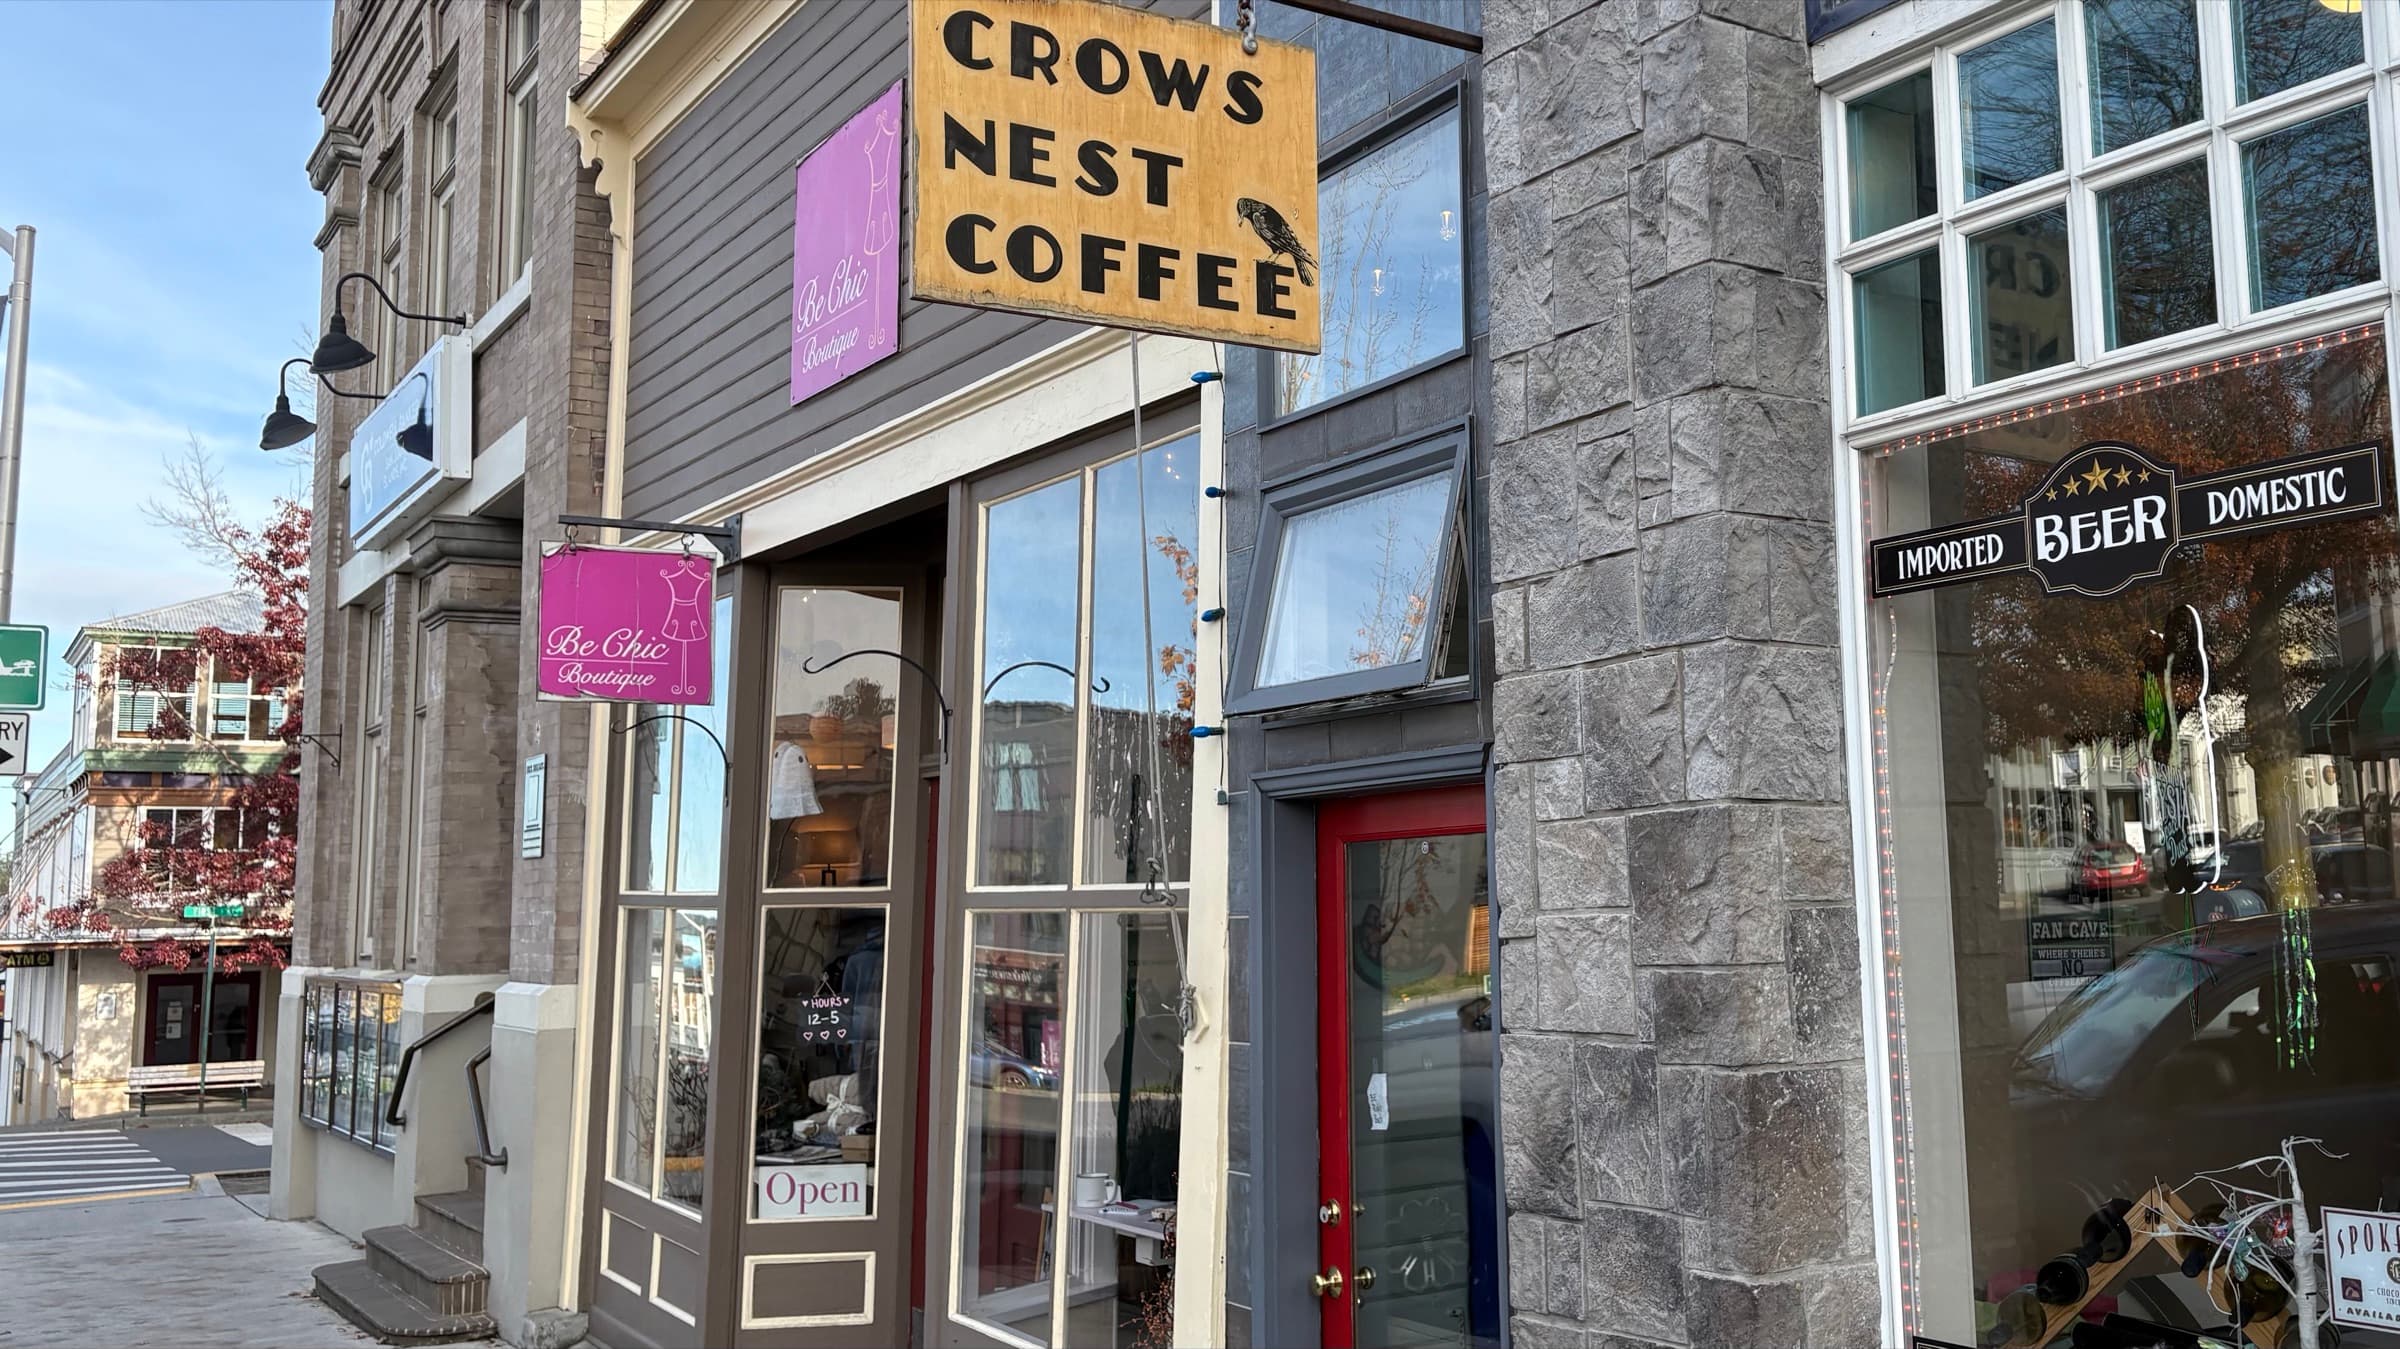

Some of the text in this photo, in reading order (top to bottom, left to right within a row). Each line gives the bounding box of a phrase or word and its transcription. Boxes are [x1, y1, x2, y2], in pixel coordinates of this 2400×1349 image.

[943, 10, 1264, 125] CROWS
[943, 112, 1184, 207] NEST
[945, 213, 1297, 321] COFFEE
[797, 254, 869, 333] Be Chic
[802, 327, 860, 374] Boutique
[2207, 466, 2347, 526] DOMESTIC
[2034, 494, 2168, 564] BEER
[1897, 533, 2004, 581] IMPORTED
[546, 625, 670, 660] Be Chic
[558, 662, 657, 694] Boutique
[2032, 920, 2109, 939] FAN CAVE
[7, 954, 34, 966] ATM
[2038, 949, 2068, 959] WHERE
[2061, 960, 2084, 977] NO
[808, 1010, 840, 1025] 12-5
[811, 996, 842, 1009] HOURS
[766, 1171, 859, 1215] Open
